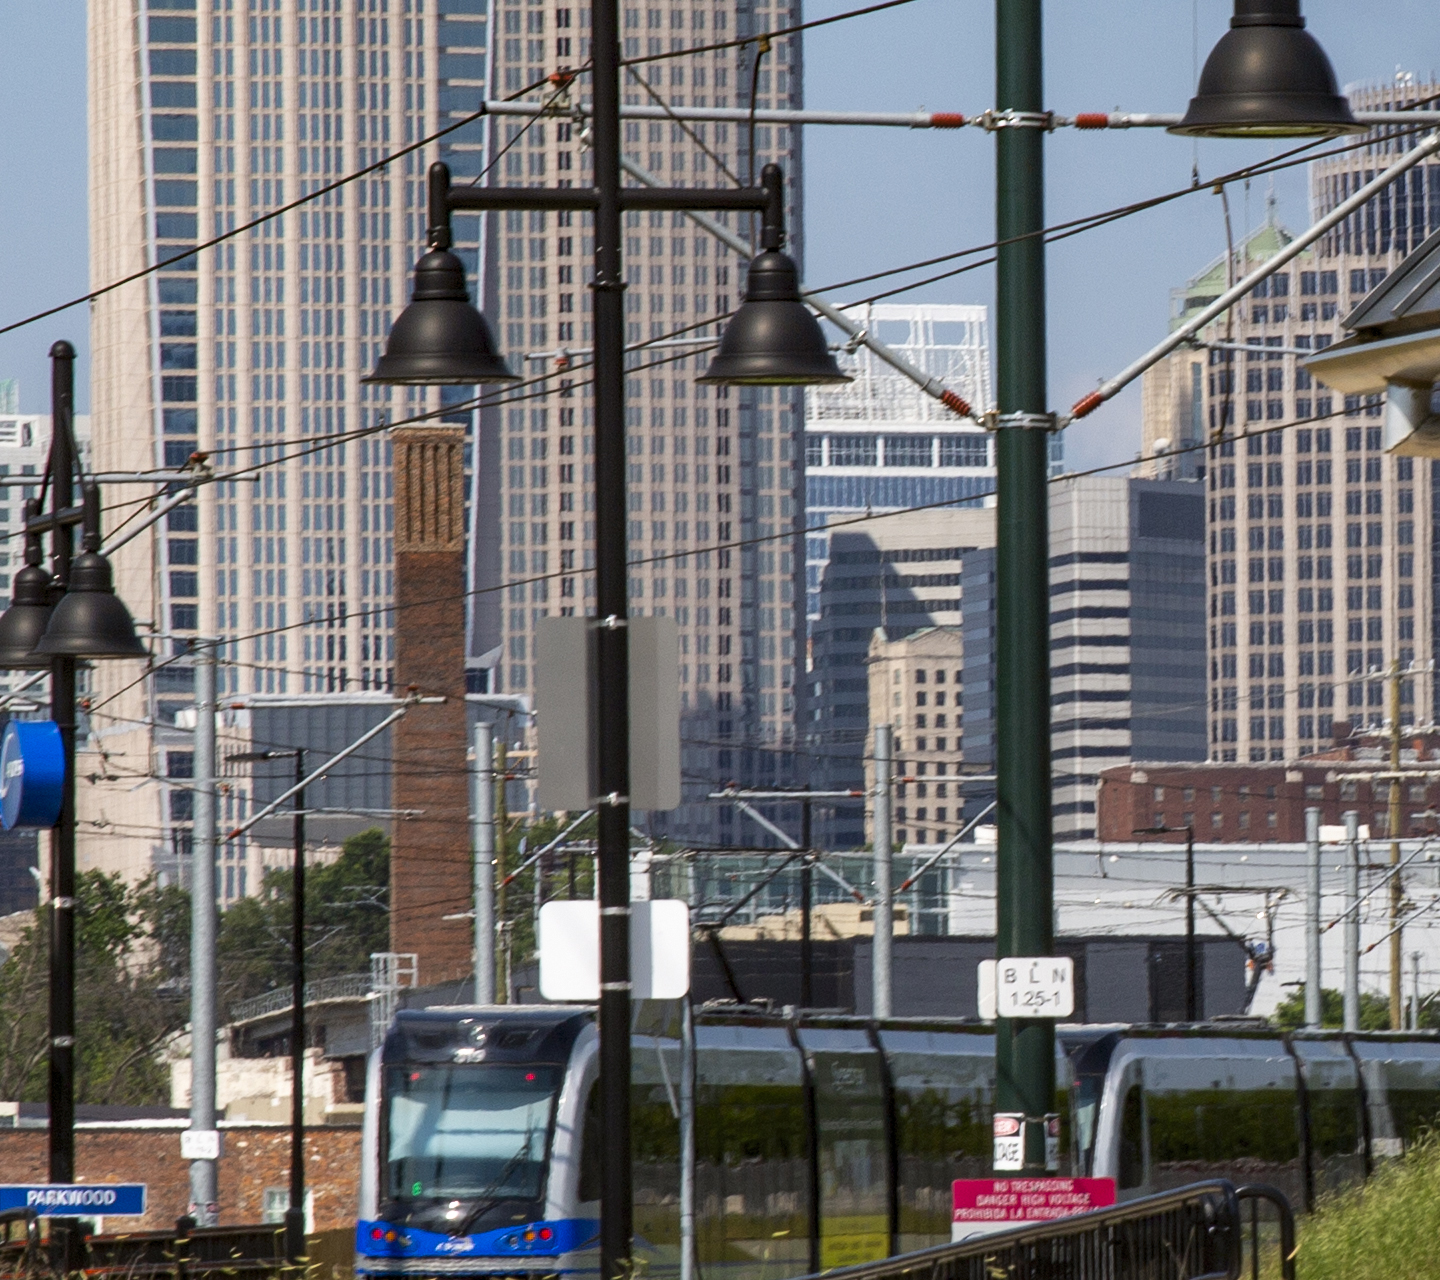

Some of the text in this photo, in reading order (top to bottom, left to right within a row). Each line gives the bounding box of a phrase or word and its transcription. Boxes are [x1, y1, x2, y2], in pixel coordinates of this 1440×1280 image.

[1004, 967, 1017, 984] B
[1029, 967, 1041, 984] L
[26, 1189, 117, 1207] PARKWOOD
[976, 1193, 1018, 1206] DANGER
[1047, 1192, 1092, 1206] VOLTAGE
